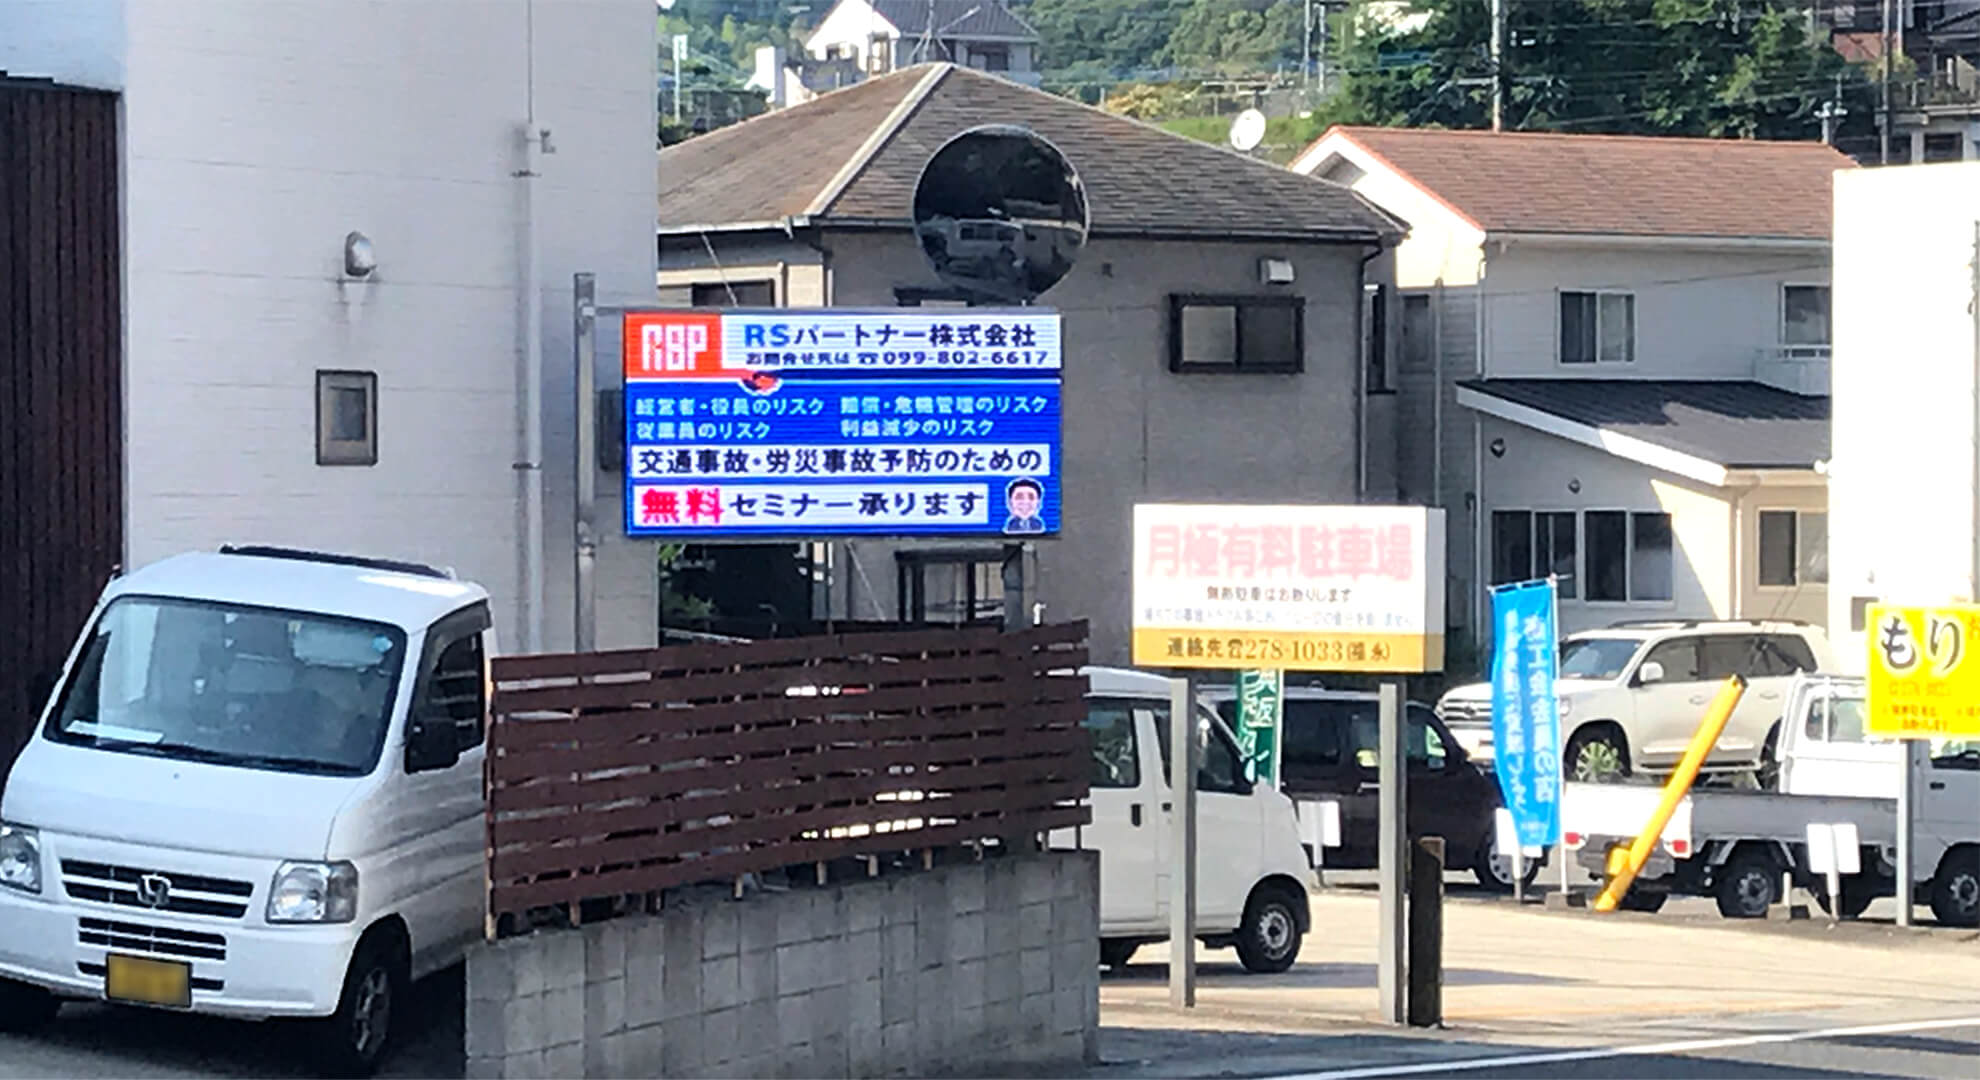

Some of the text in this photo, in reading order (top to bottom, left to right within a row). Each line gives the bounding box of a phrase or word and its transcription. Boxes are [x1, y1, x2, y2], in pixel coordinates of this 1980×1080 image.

[745, 324, 1036, 347] RSパートナー株式会社
[883, 351, 1048, 365] 099-802-6617
[639, 449, 1042, 474] 交通事故・労災事故予防のための
[1147, 523, 1413, 581] 月極有料駐車場
[1880, 616, 1961, 671] もり
